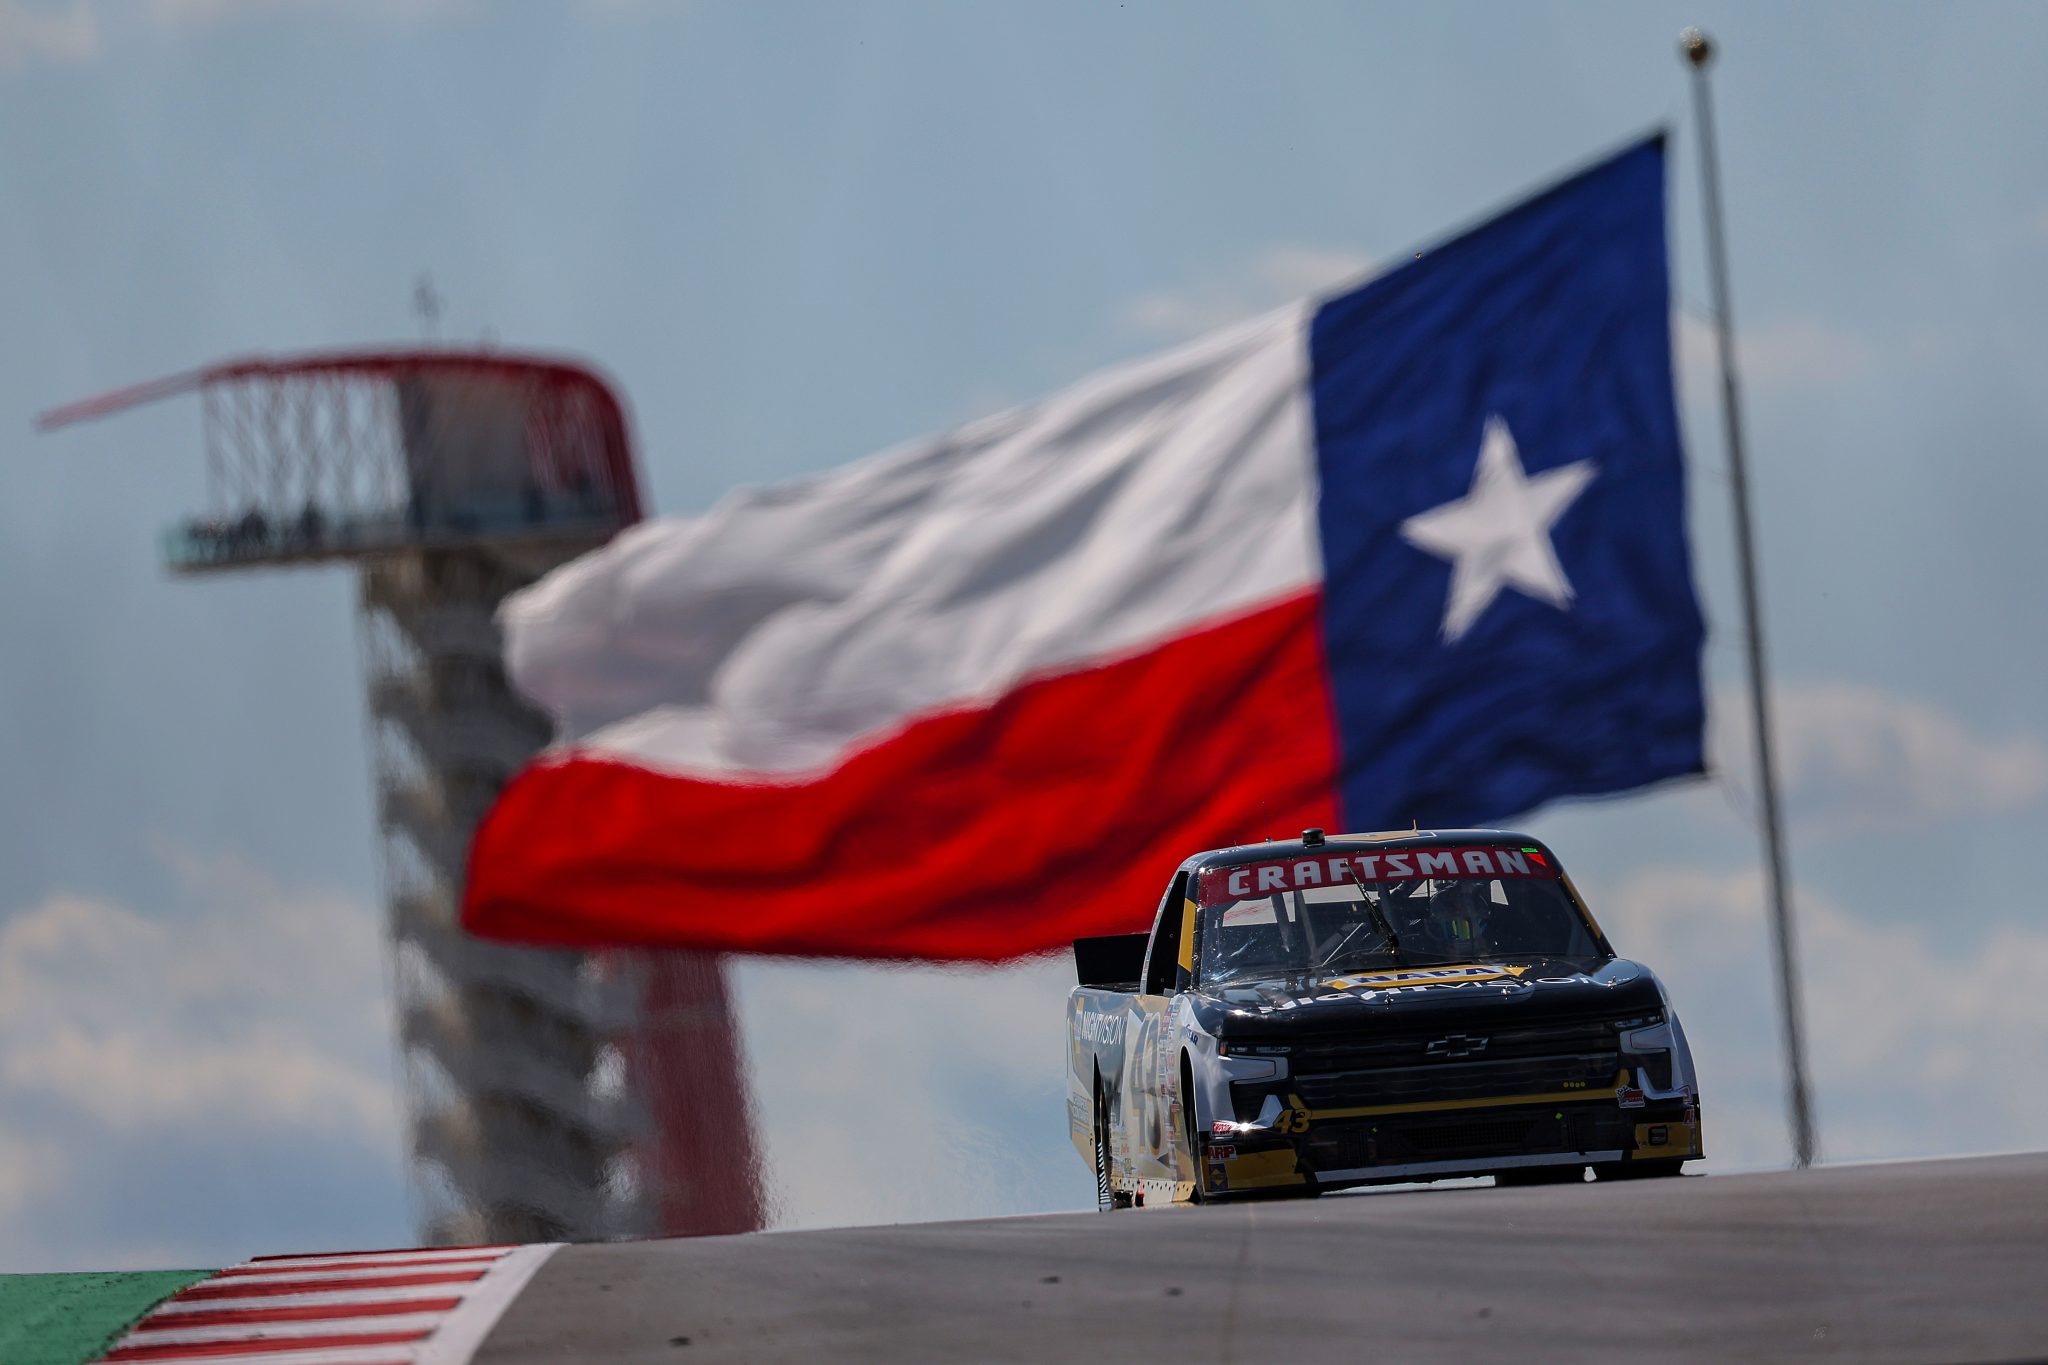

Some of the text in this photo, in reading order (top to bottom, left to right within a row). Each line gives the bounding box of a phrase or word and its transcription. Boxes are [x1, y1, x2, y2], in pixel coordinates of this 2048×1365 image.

[1228, 850, 1531, 895] CRAFTSMAN
[1355, 967, 1500, 984] NAPA
[1273, 1109, 1311, 1134] 43
[1208, 1145, 1235, 1159] ARP
